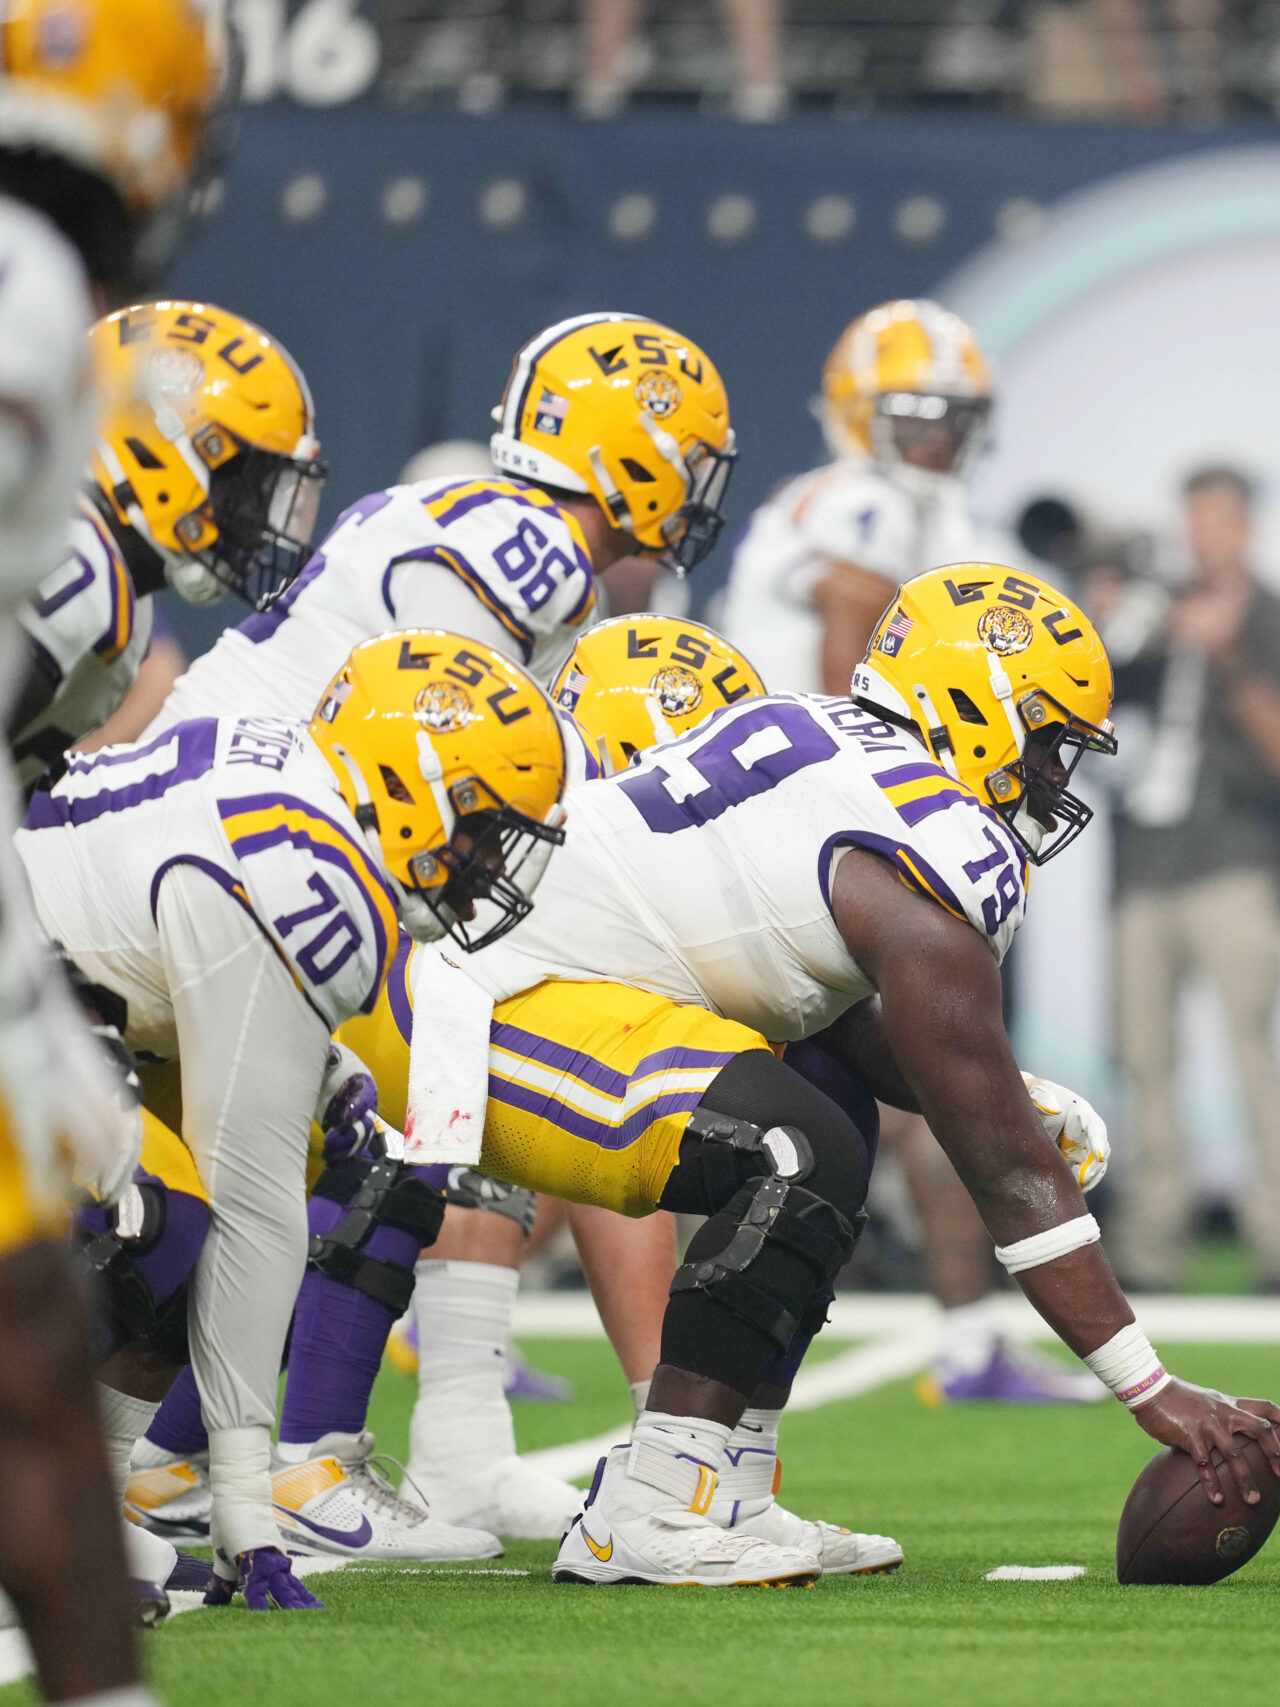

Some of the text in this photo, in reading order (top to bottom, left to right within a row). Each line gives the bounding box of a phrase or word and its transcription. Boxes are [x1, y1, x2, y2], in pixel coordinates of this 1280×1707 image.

[234, 0, 381, 106] 16
[118, 314, 264, 375] LSU
[587, 334, 702, 384] LSU
[491, 517, 577, 613] 66
[943, 576, 1083, 645] LSU
[397, 641, 531, 725] LSU
[628, 629, 751, 705] LSU
[961, 825, 1020, 936] 79
[274, 871, 362, 985] 70
